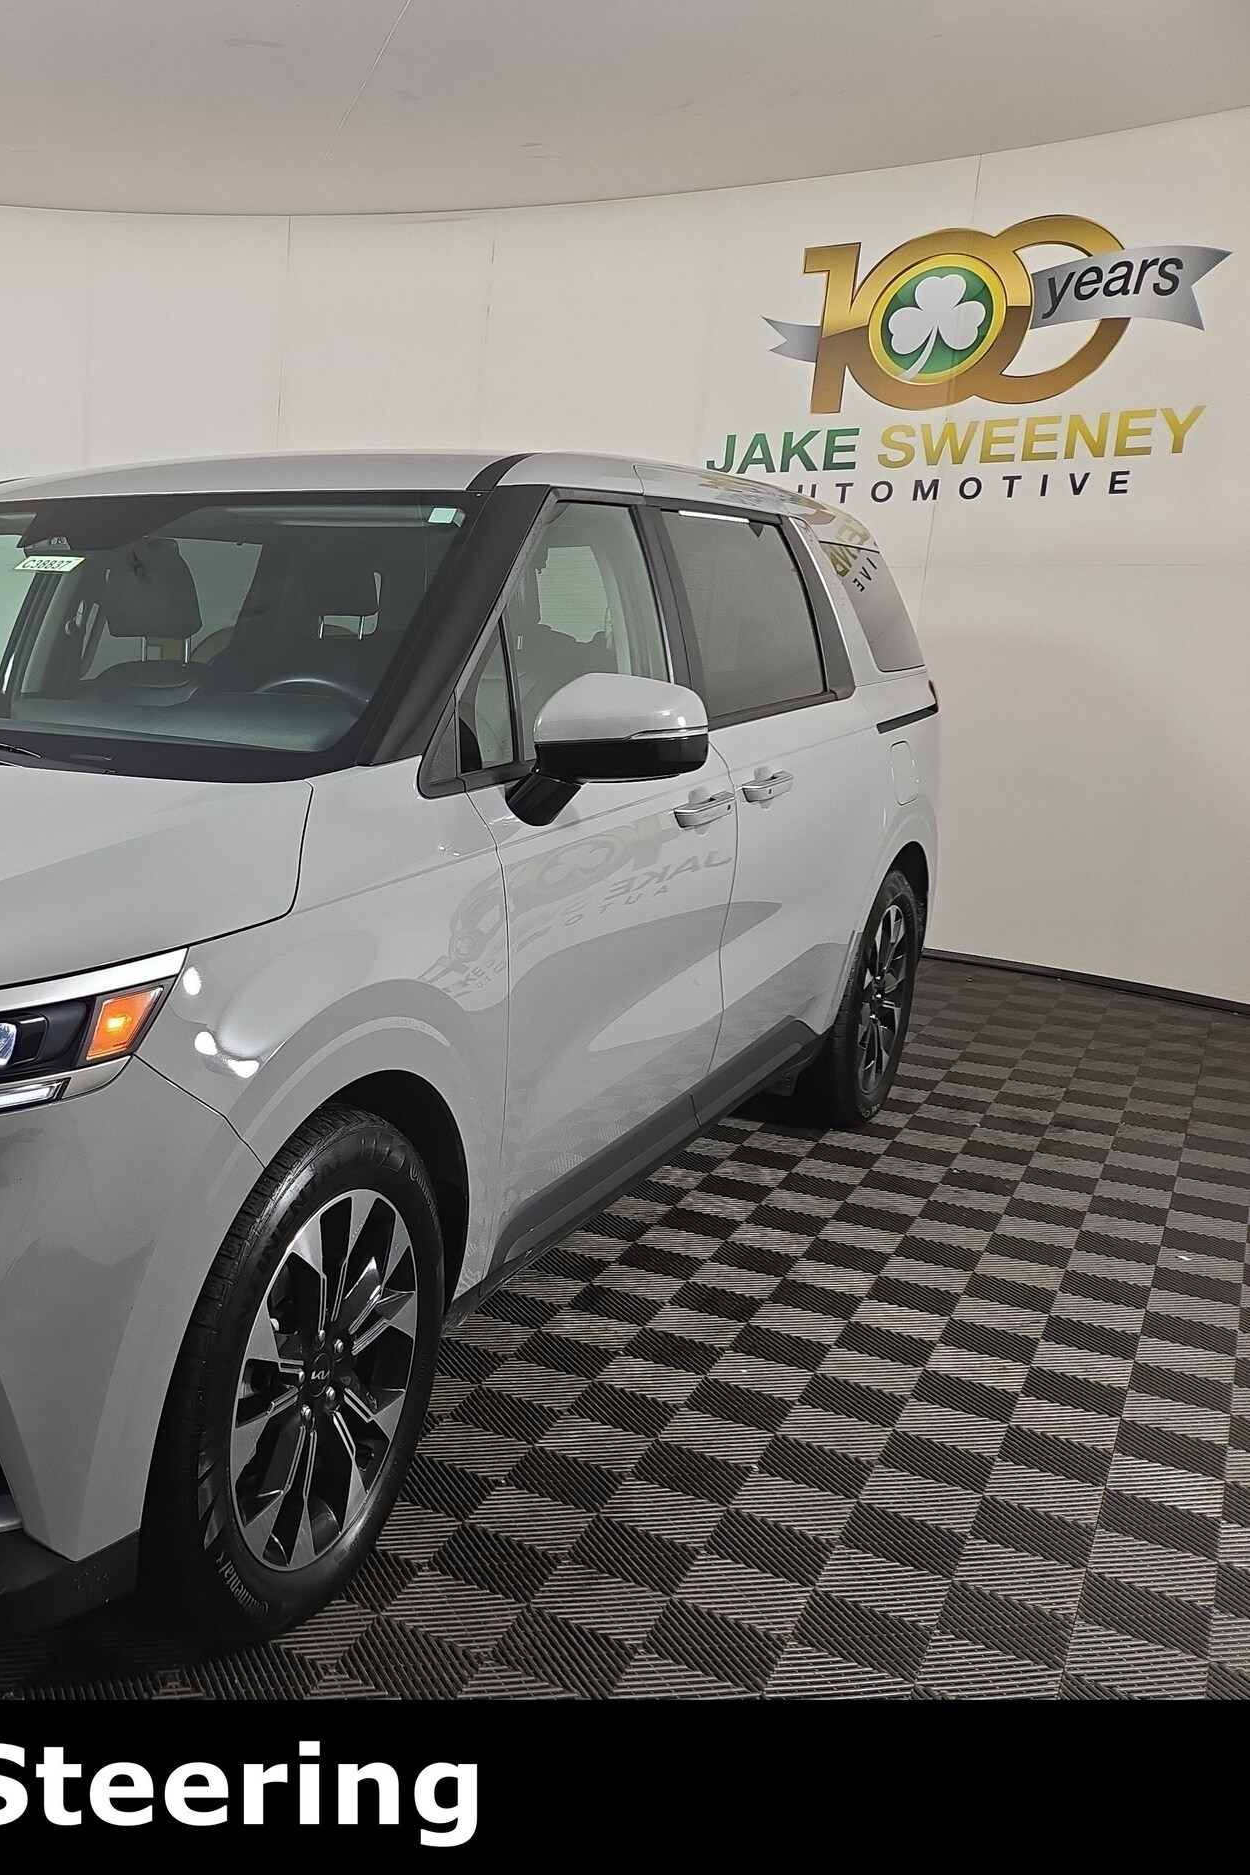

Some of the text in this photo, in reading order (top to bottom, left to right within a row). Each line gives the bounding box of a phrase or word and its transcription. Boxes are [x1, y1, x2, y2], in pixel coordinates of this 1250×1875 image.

[1040, 256, 1184, 319] years
[706, 404, 1208, 474] JAKE SWEENEY
[797, 470, 1133, 504] TOMOTIVE
[22, 559, 73, 569] C38837
